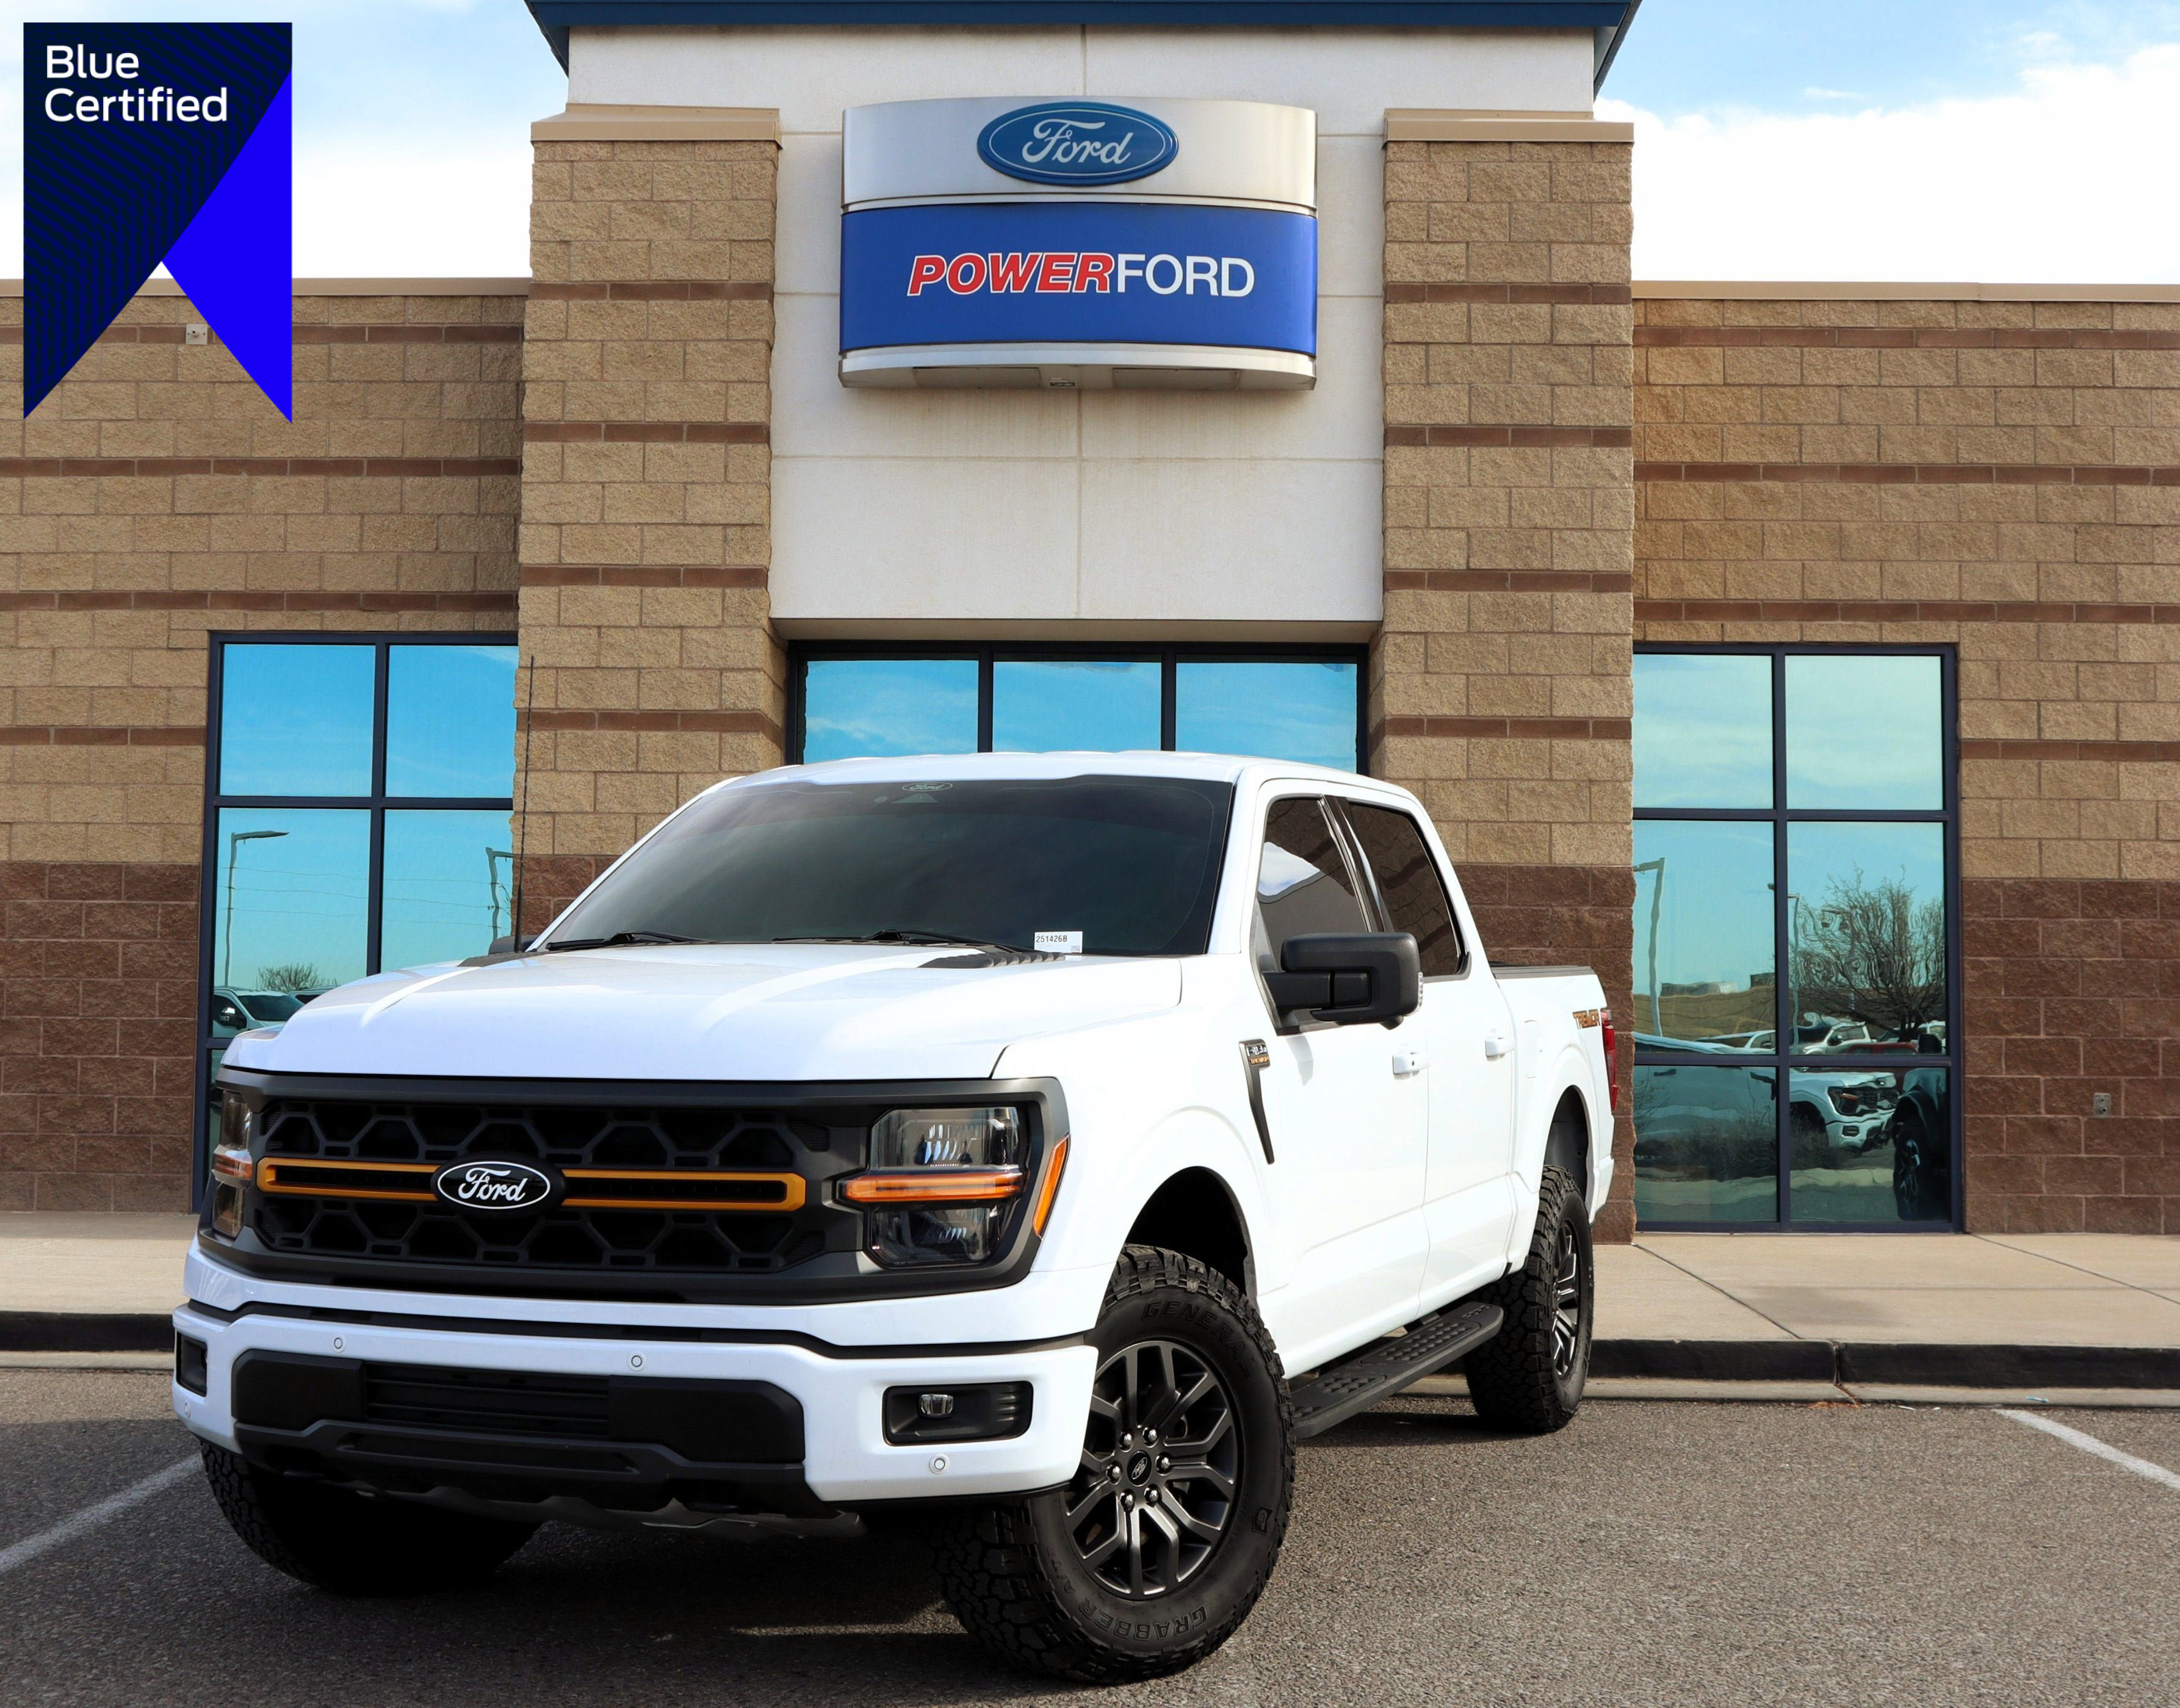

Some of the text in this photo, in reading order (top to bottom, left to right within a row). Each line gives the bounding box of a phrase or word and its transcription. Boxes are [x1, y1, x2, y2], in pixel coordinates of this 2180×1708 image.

[1021, 118, 1134, 165] Ford
[458, 1167, 529, 1202] Ford
[1142, 1299, 1255, 1378] GENERAL
[1078, 1596, 1207, 1641] GRABBER
